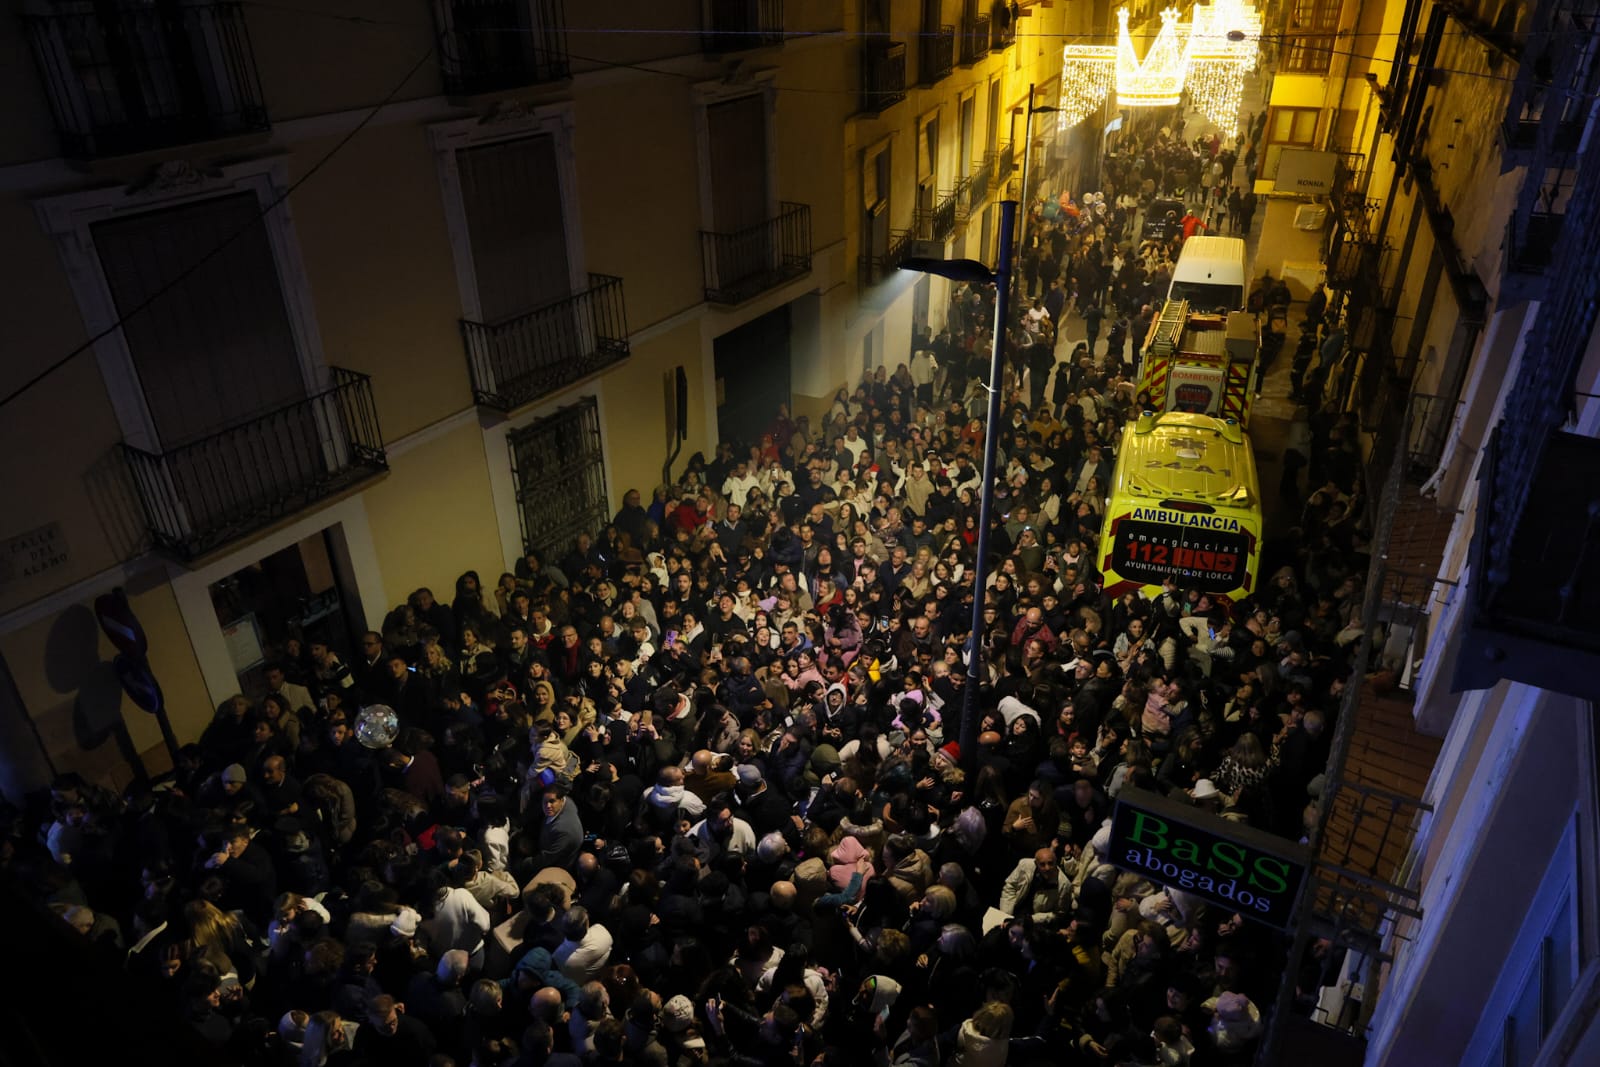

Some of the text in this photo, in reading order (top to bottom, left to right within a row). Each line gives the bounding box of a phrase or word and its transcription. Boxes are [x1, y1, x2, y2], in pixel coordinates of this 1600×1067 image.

[1172, 371, 1221, 382] BOMBEROS
[1132, 507, 1239, 531] AMBULANCIA
[10, 529, 56, 554] CALLE
[30, 543, 56, 560] DEL
[1126, 541, 1168, 565] 112
[1128, 533, 1239, 553] emergencias
[1125, 561, 1233, 581] AYUNTAMIENTO DE LORCA
[1124, 808, 1291, 895] BaSS
[1125, 848, 1271, 914] abogados
